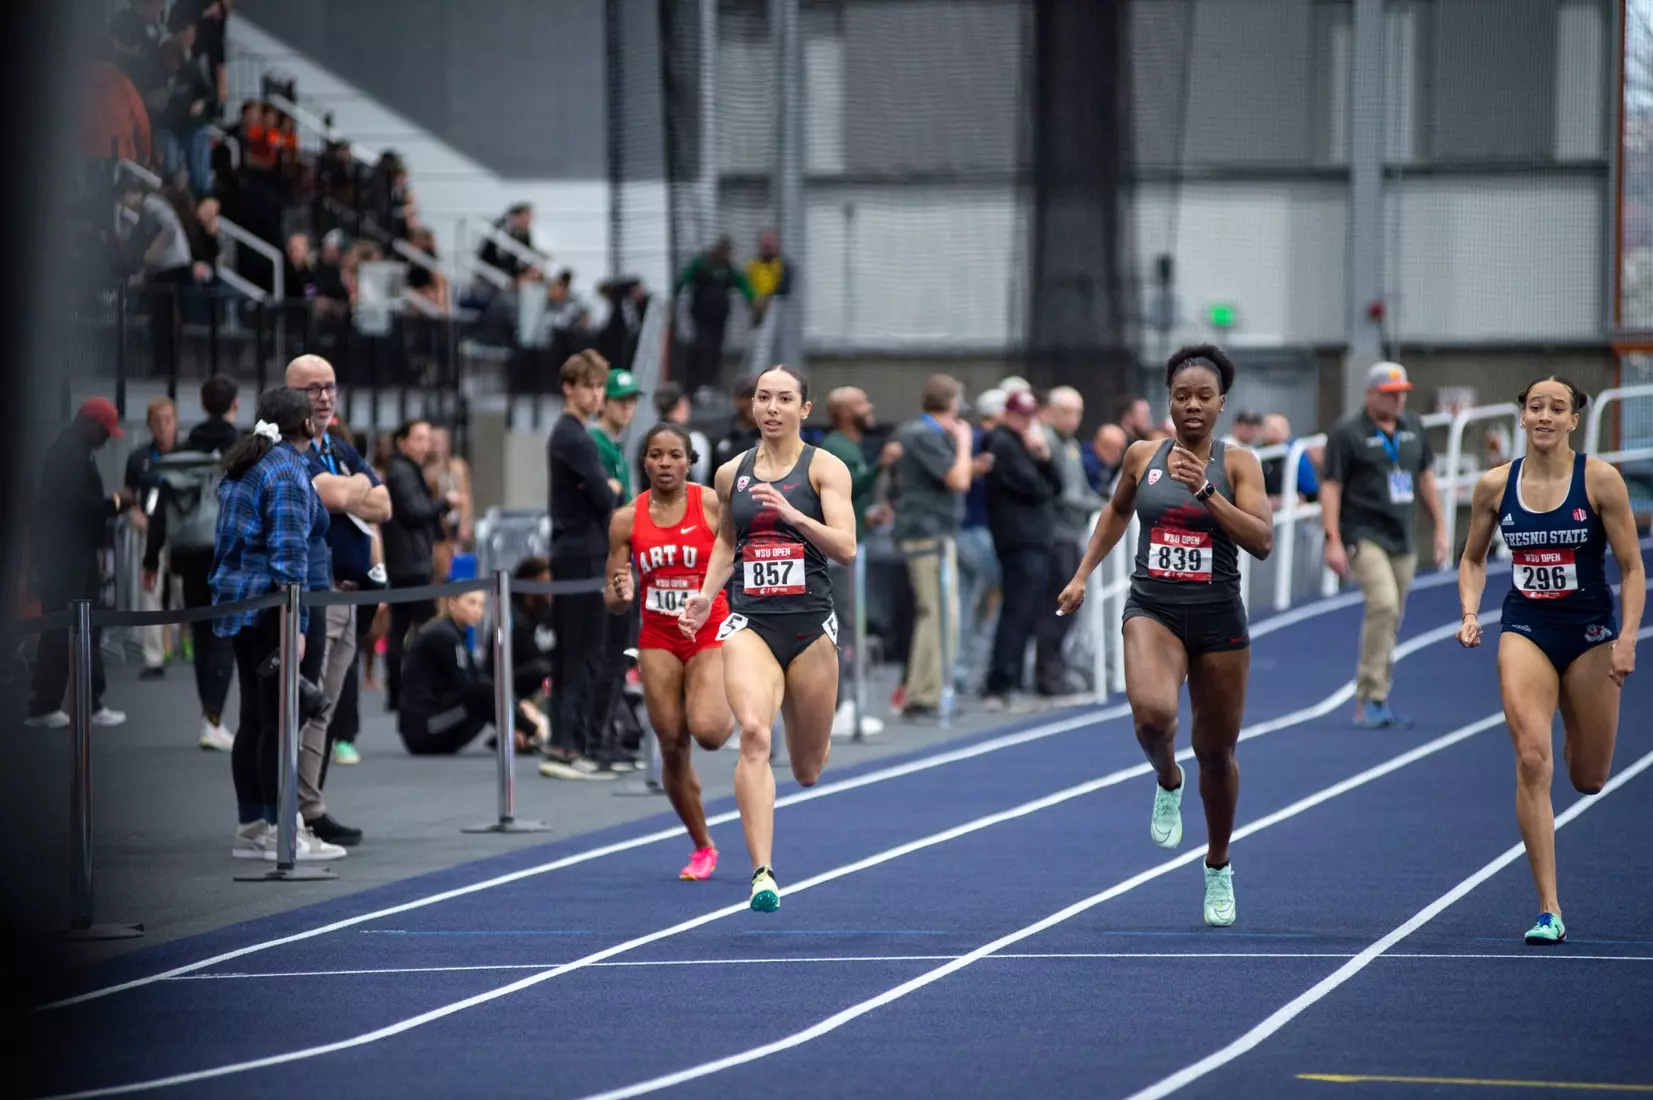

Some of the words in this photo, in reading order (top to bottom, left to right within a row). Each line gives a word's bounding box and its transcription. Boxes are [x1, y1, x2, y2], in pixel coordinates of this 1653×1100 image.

[1164, 532, 1180, 543] WSU
[1181, 535, 1200, 545] OPEN
[1504, 531, 1548, 546] FRESNO
[1549, 528, 1588, 544] STATE
[682, 545, 698, 568] U
[754, 549, 771, 558] WSU
[772, 548, 791, 557] OPEN
[1158, 546, 1202, 571] 839
[1524, 554, 1540, 563] WSU
[1541, 553, 1561, 563] OPEN
[671, 579, 688, 588] OPEN
[753, 561, 794, 587] 857
[1522, 566, 1567, 590] 296
[720, 614, 743, 638] 5
